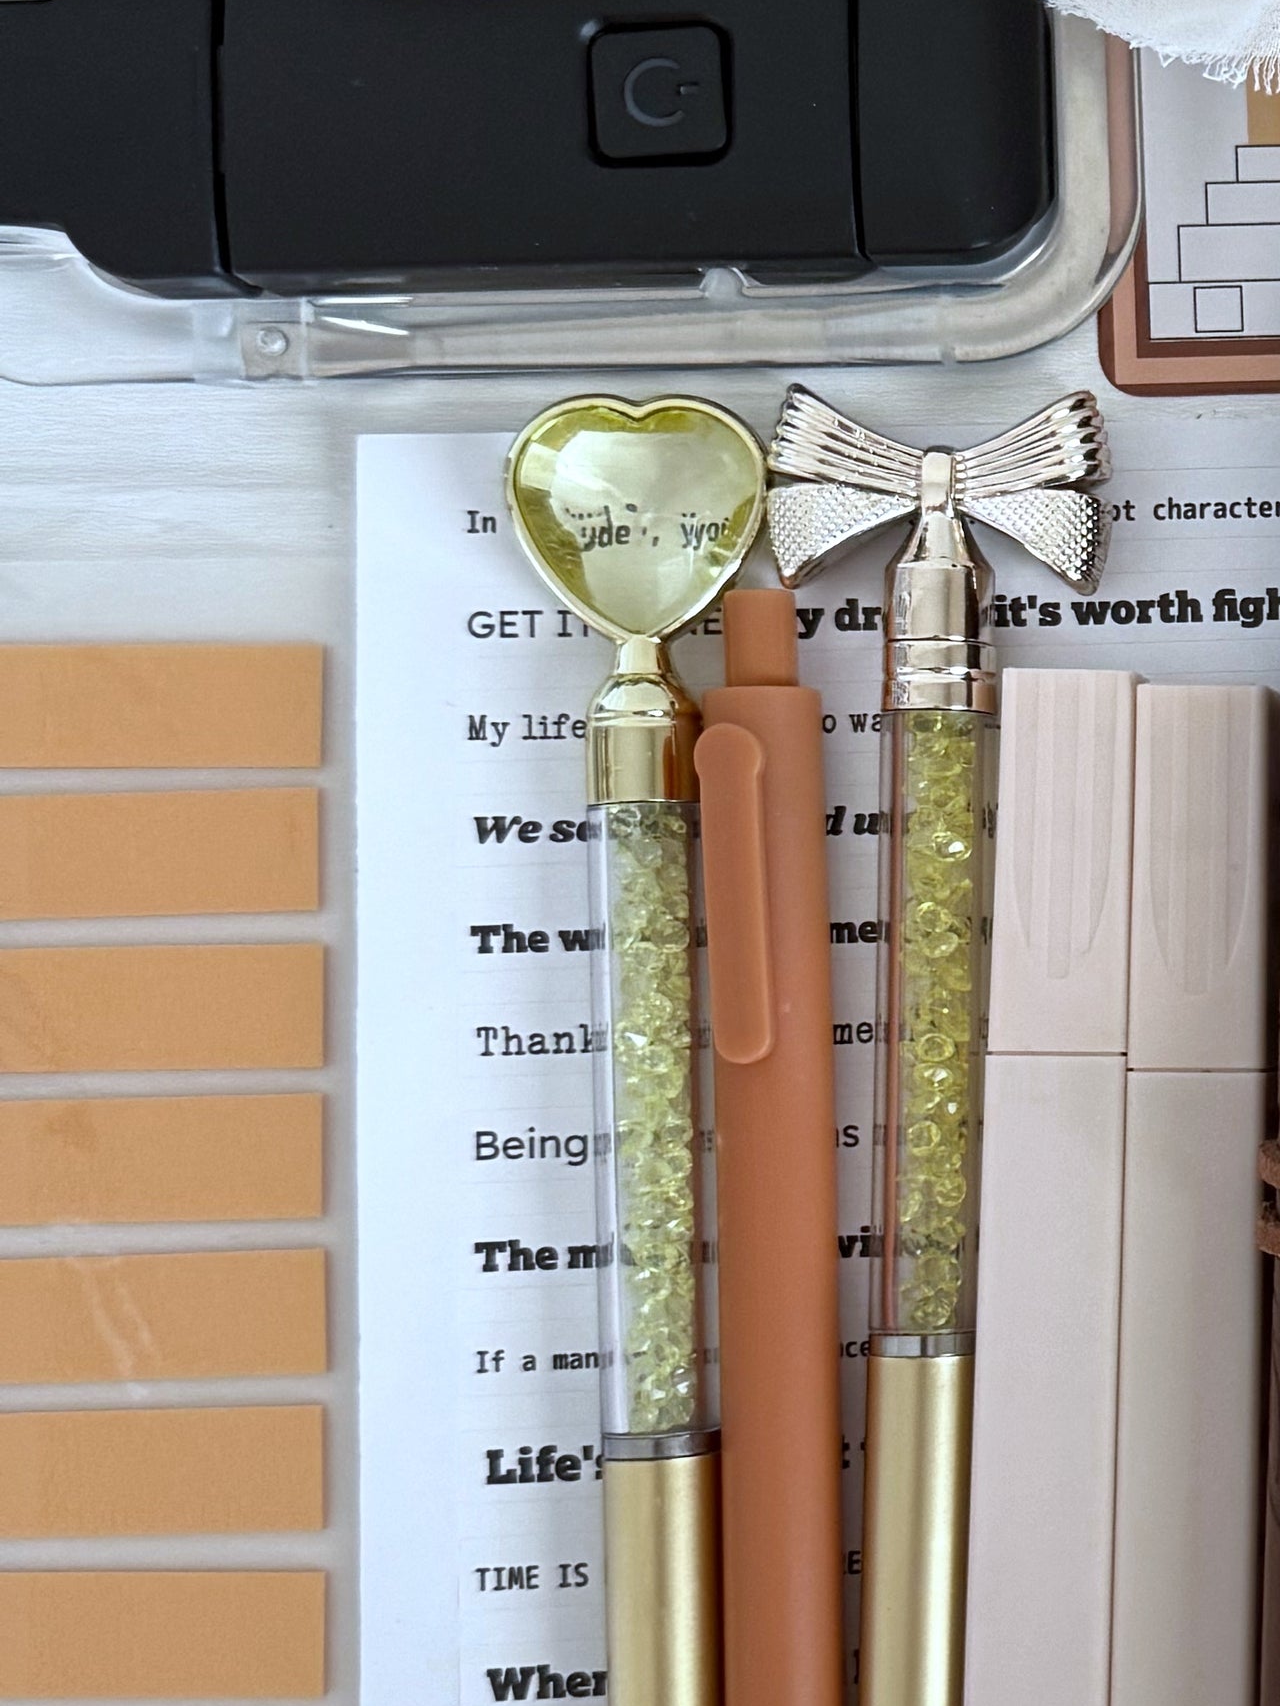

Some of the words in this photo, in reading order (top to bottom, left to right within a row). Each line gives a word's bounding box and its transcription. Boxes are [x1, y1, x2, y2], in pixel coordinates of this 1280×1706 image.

[466, 510, 497, 535] In
[1070, 589, 1203, 625] worth
[467, 610, 543, 639] GET
[467, 714, 514, 747] My
[473, 815, 543, 845] We
[470, 923, 550, 954] The
[474, 1238, 560, 1272] The
[475, 1349, 505, 1374] If
[521, 1351, 538, 1372] a
[476, 1564, 540, 1592] TIME
[558, 1562, 590, 1589] IS
